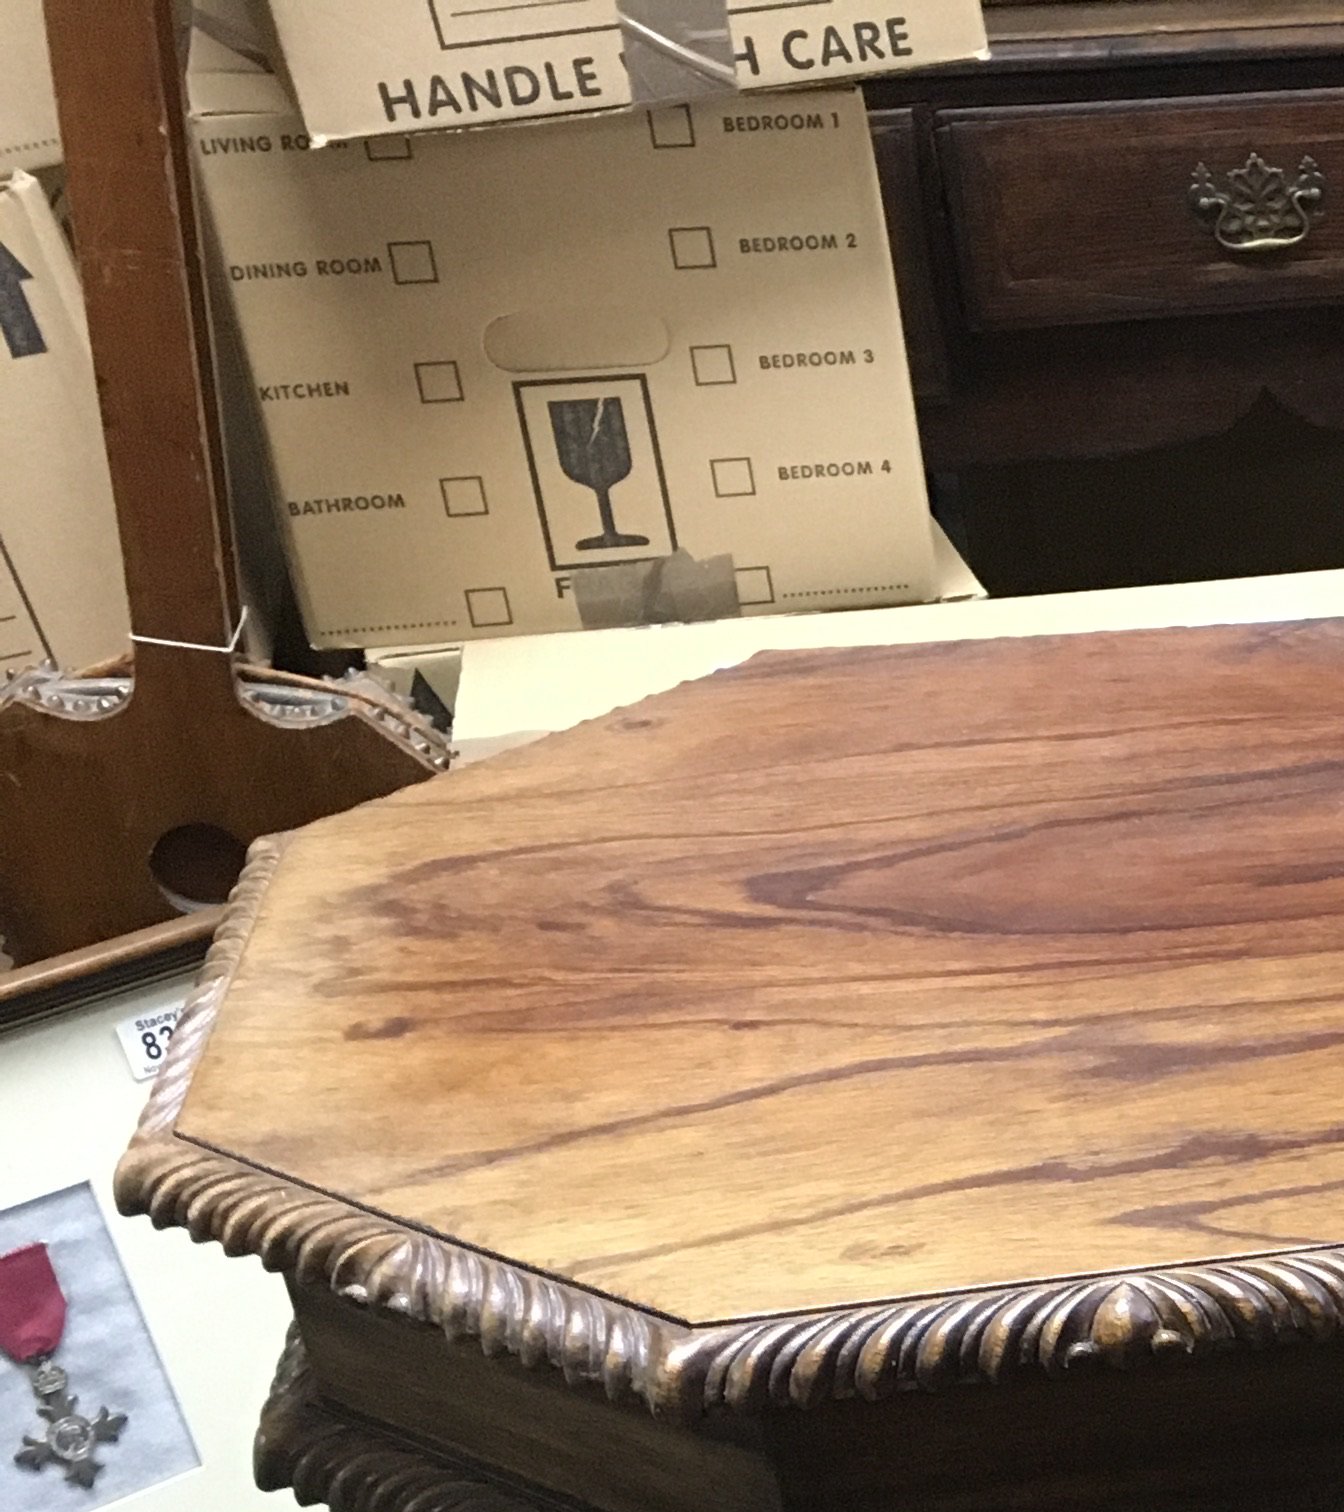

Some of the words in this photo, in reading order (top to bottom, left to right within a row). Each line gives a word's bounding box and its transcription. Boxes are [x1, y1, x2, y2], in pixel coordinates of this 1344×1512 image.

[377, 56, 602, 122] HANDLE
[782, 17, 913, 70] CARE
[723, 114, 823, 132] BEDROOM
[831, 112, 840, 129] 1
[200, 136, 272, 155] LIVING
[281, 134, 348, 150] RO
[739, 234, 838, 254] BEDROOM
[845, 233, 858, 248] 2
[230, 262, 308, 281] DINING
[316, 257, 382, 276] ROOM
[759, 350, 856, 370] BEDROOM
[863, 349, 875, 364] 3
[259, 381, 350, 401] KITCHEN
[777, 461, 873, 481] BEDROOM
[881, 459, 892, 474] 4
[288, 494, 405, 516] BATHROOM
